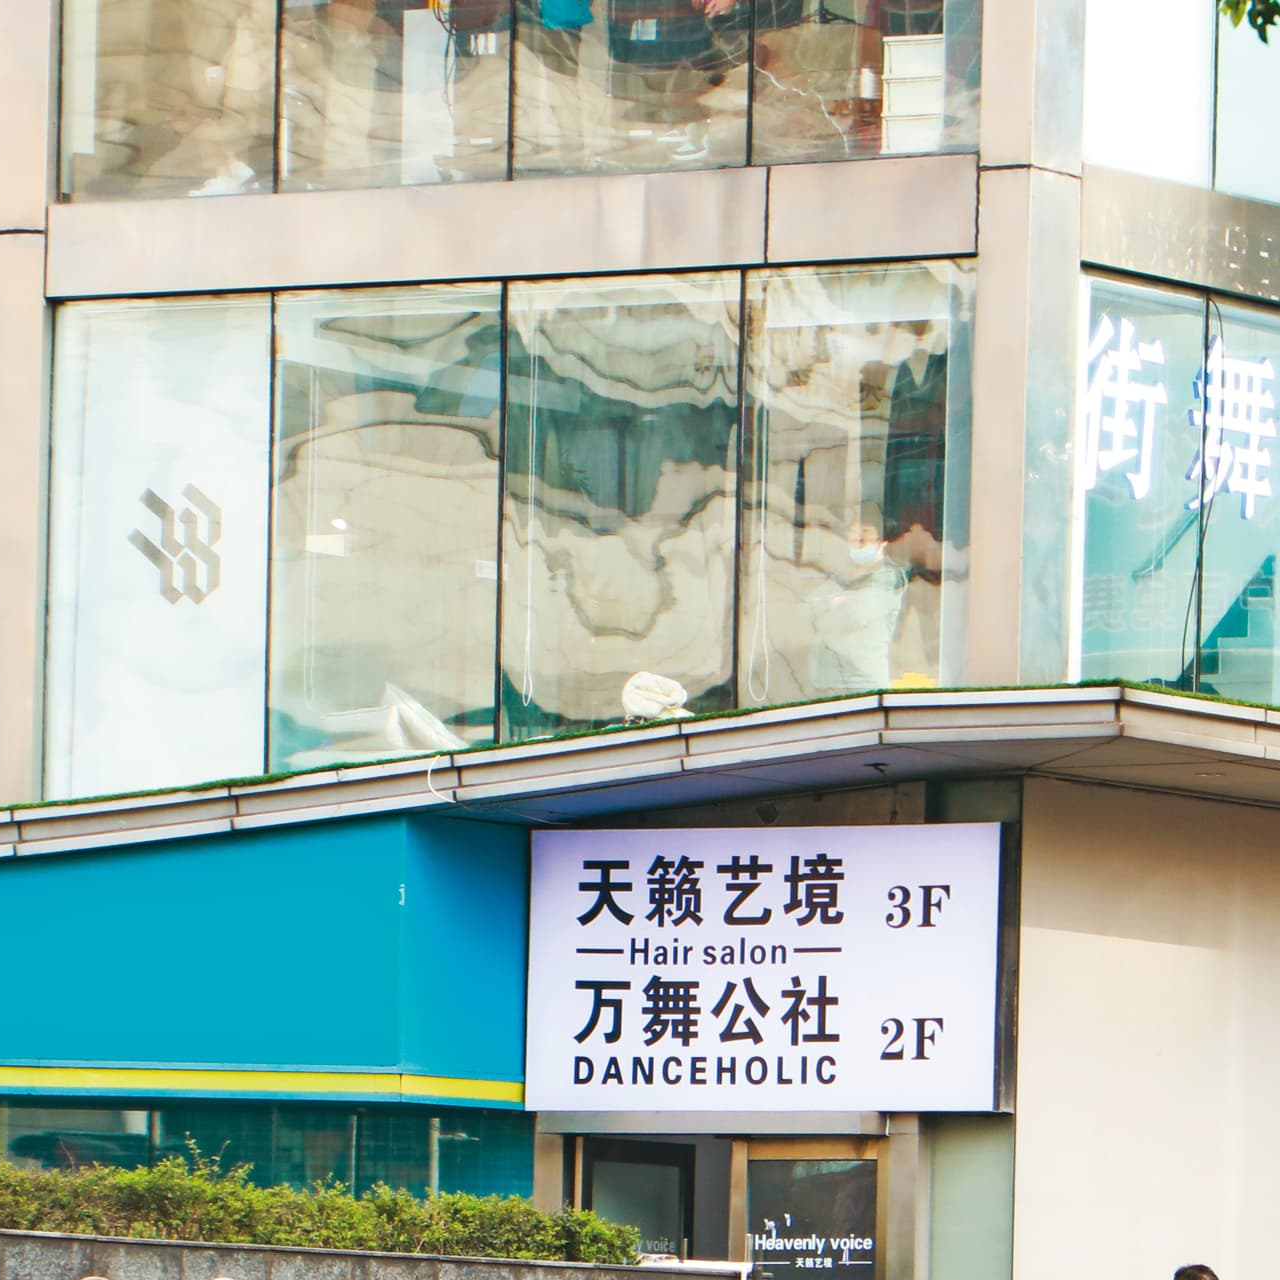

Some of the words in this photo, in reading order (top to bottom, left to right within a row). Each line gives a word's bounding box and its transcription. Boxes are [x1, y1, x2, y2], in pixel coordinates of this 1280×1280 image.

[1081, 312, 1277, 520] 街舞
[576, 853, 845, 927] 天籁艺境
[885, 884, 951, 928] 3F
[629, 937, 693, 965] Hair
[702, 938, 788, 965] salon
[573, 975, 840, 1047] 万舞公社
[880, 1017, 944, 1061] 2F
[573, 1056, 837, 1085] DANCEHOLIC
[754, 1233, 826, 1254] Heavenly
[830, 1233, 873, 1250] voice
